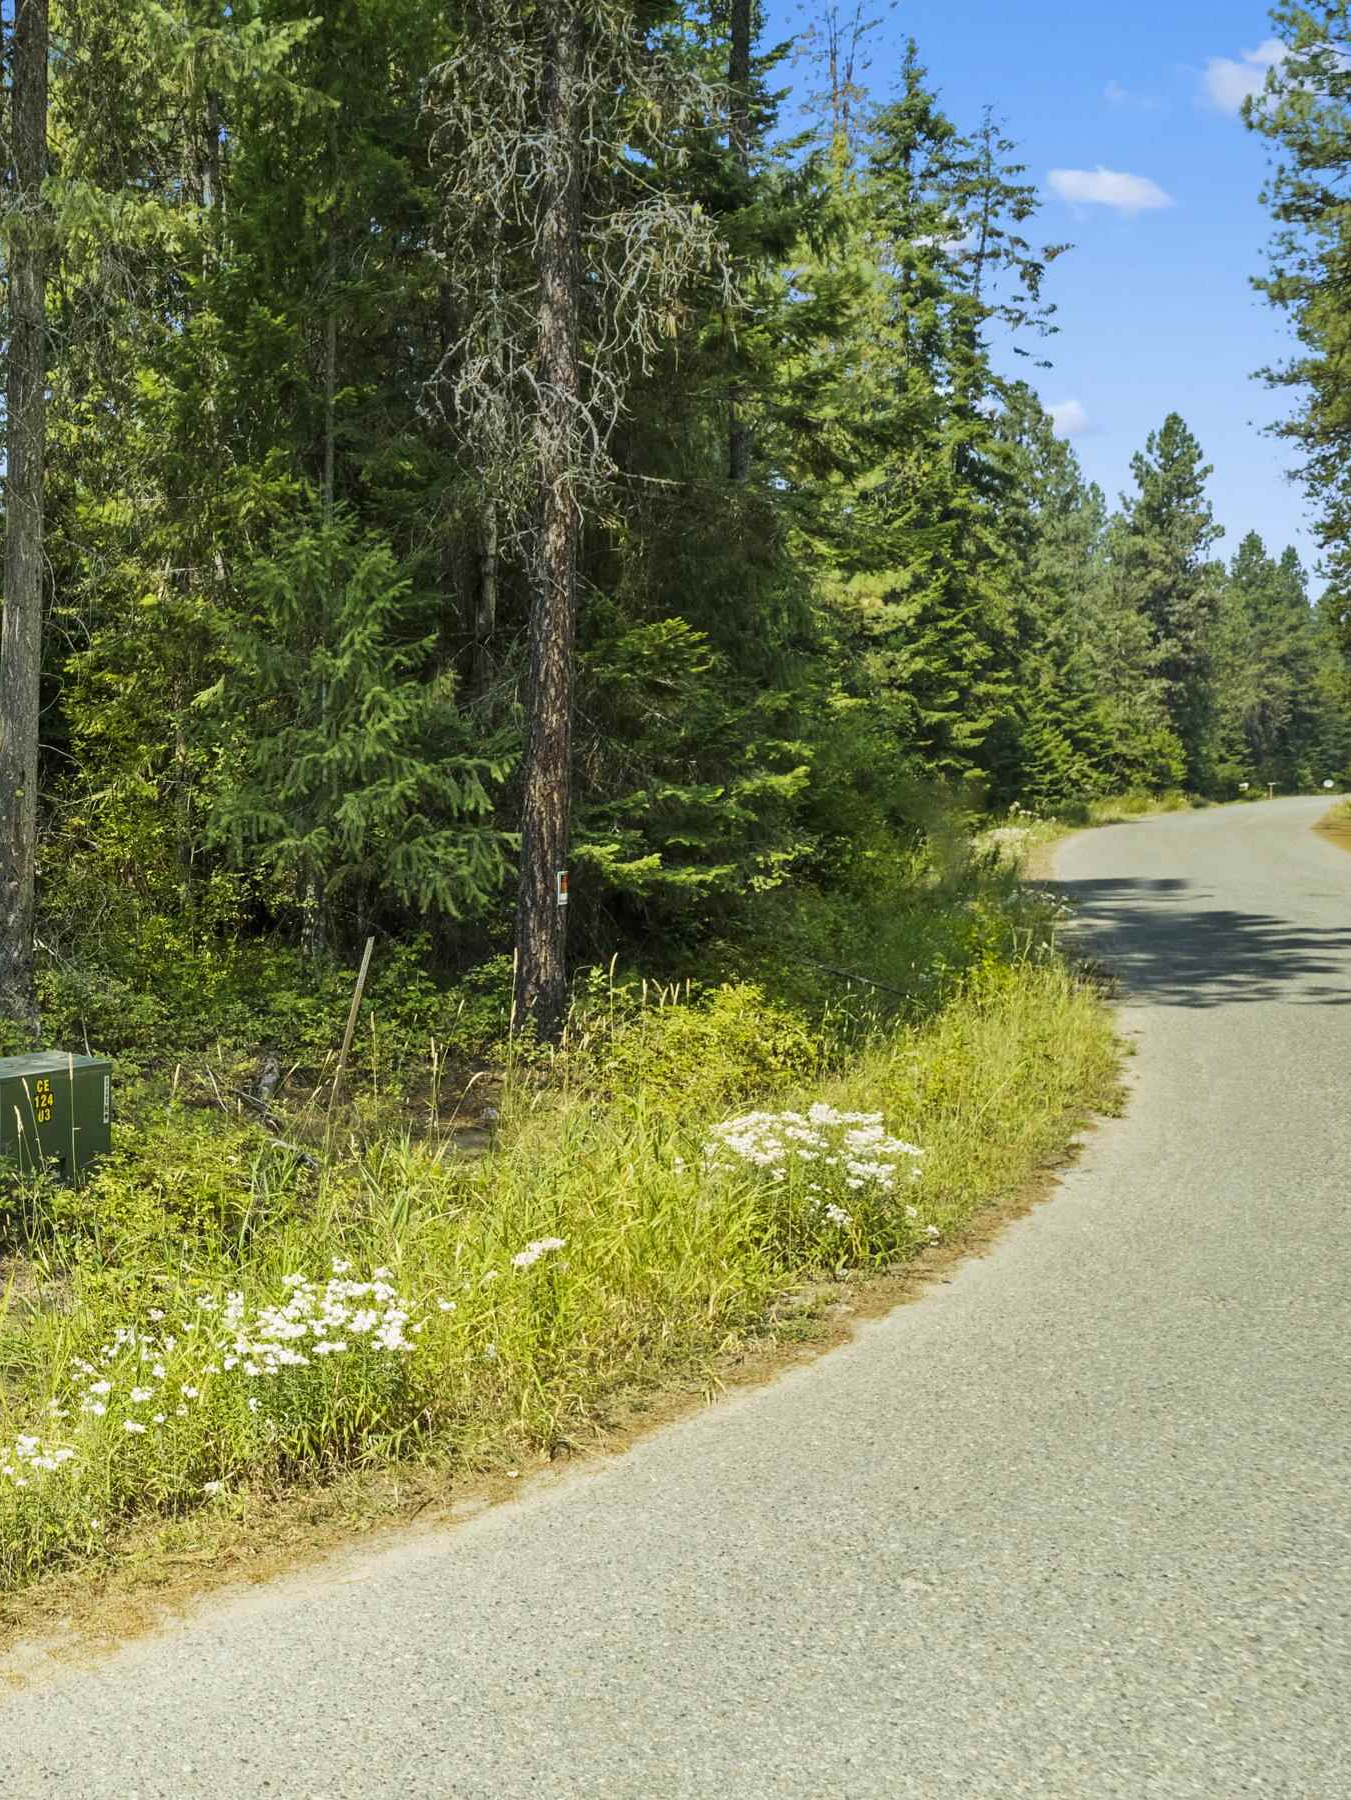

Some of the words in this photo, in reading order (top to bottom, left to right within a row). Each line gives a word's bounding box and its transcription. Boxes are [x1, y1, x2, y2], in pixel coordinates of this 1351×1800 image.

[36, 1079, 50, 1093] CE
[34, 1093, 54, 1108] 124
[38, 1108, 51, 1122] U3
